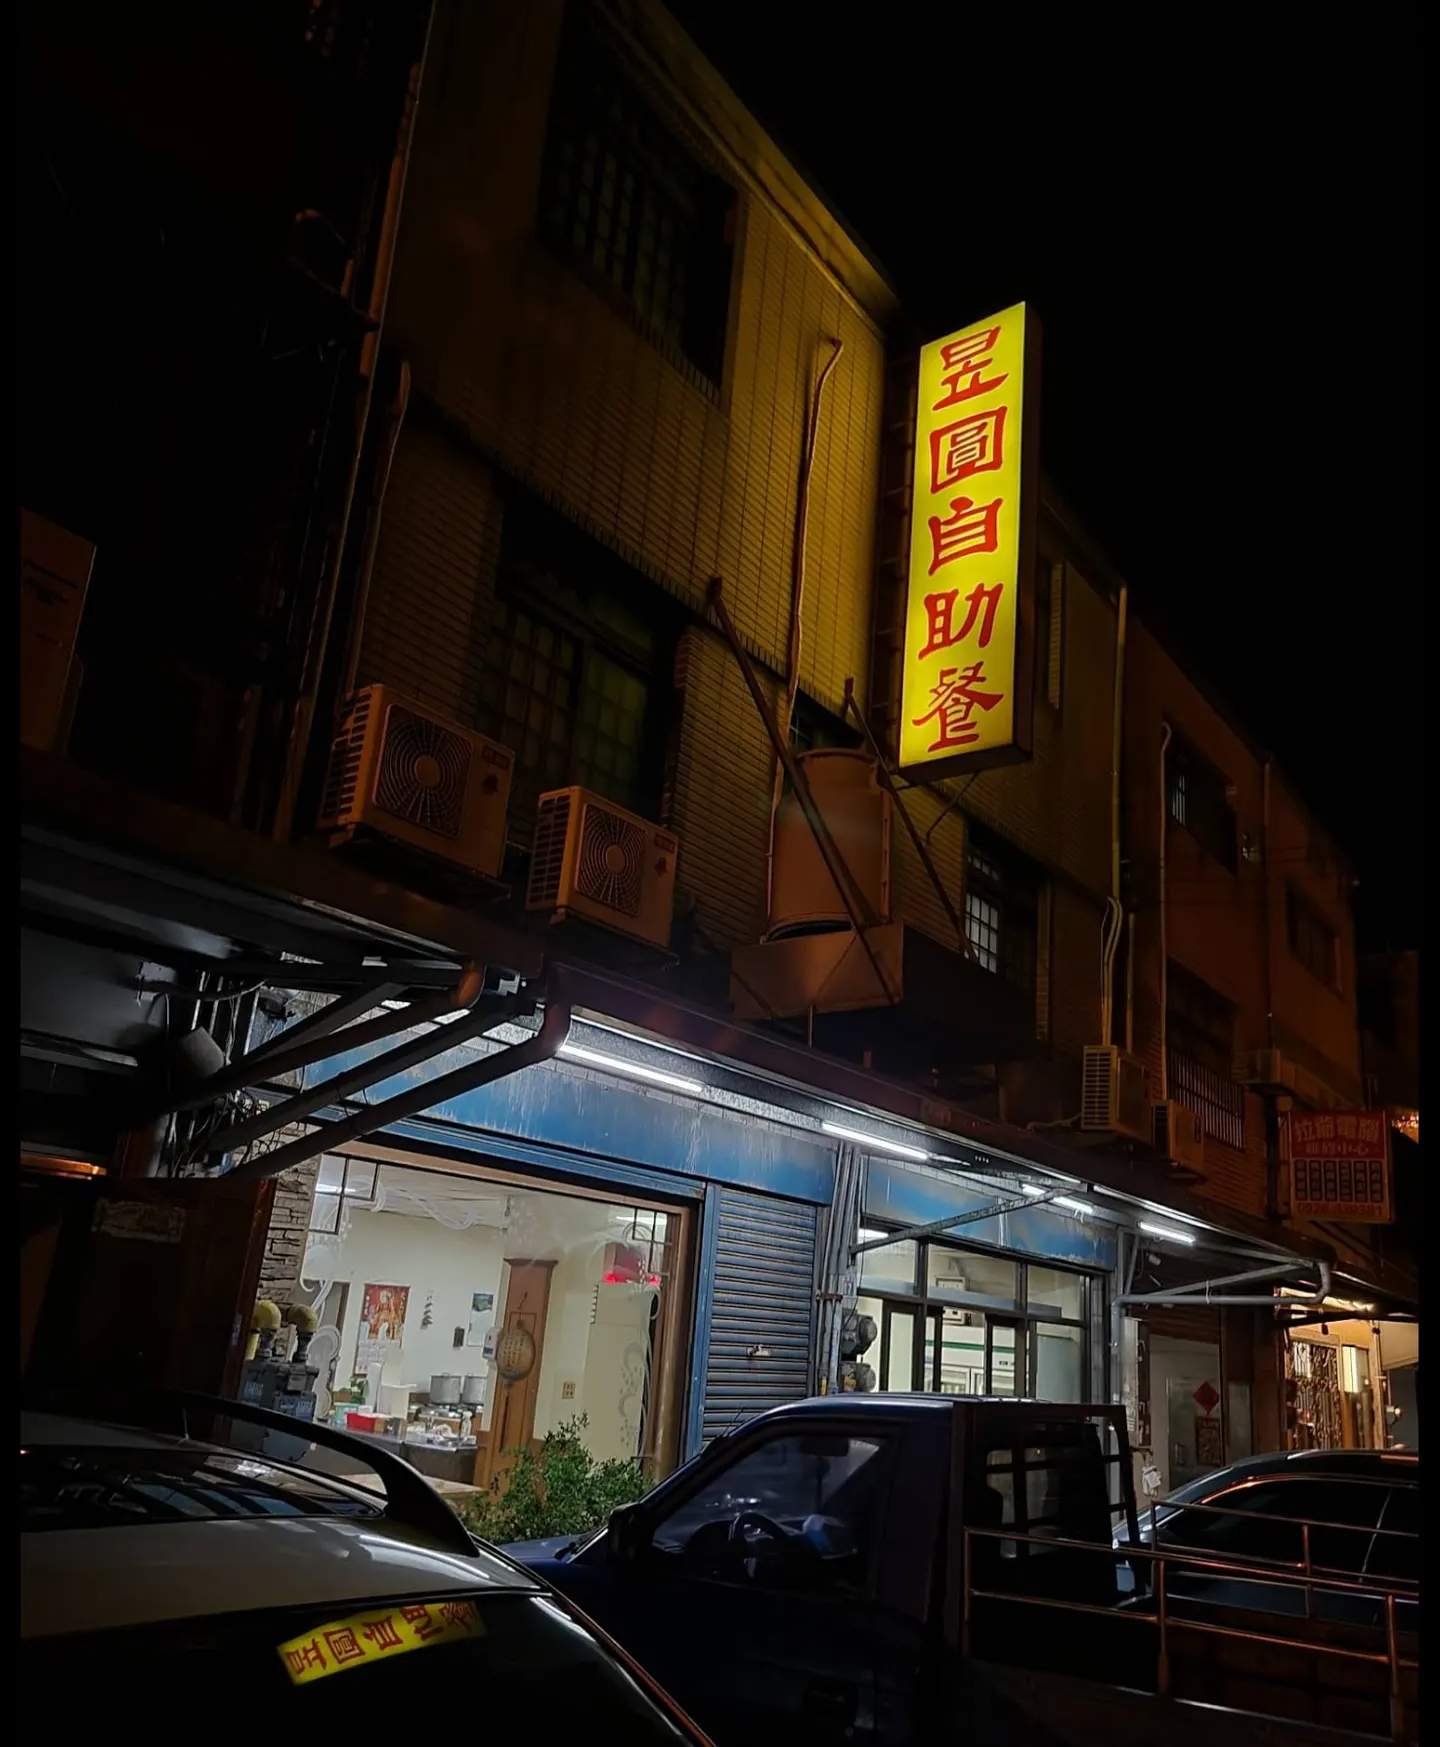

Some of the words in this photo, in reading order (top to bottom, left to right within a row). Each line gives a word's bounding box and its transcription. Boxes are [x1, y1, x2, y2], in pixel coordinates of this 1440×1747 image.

[913, 326, 1008, 752] 昱圓自助餐
